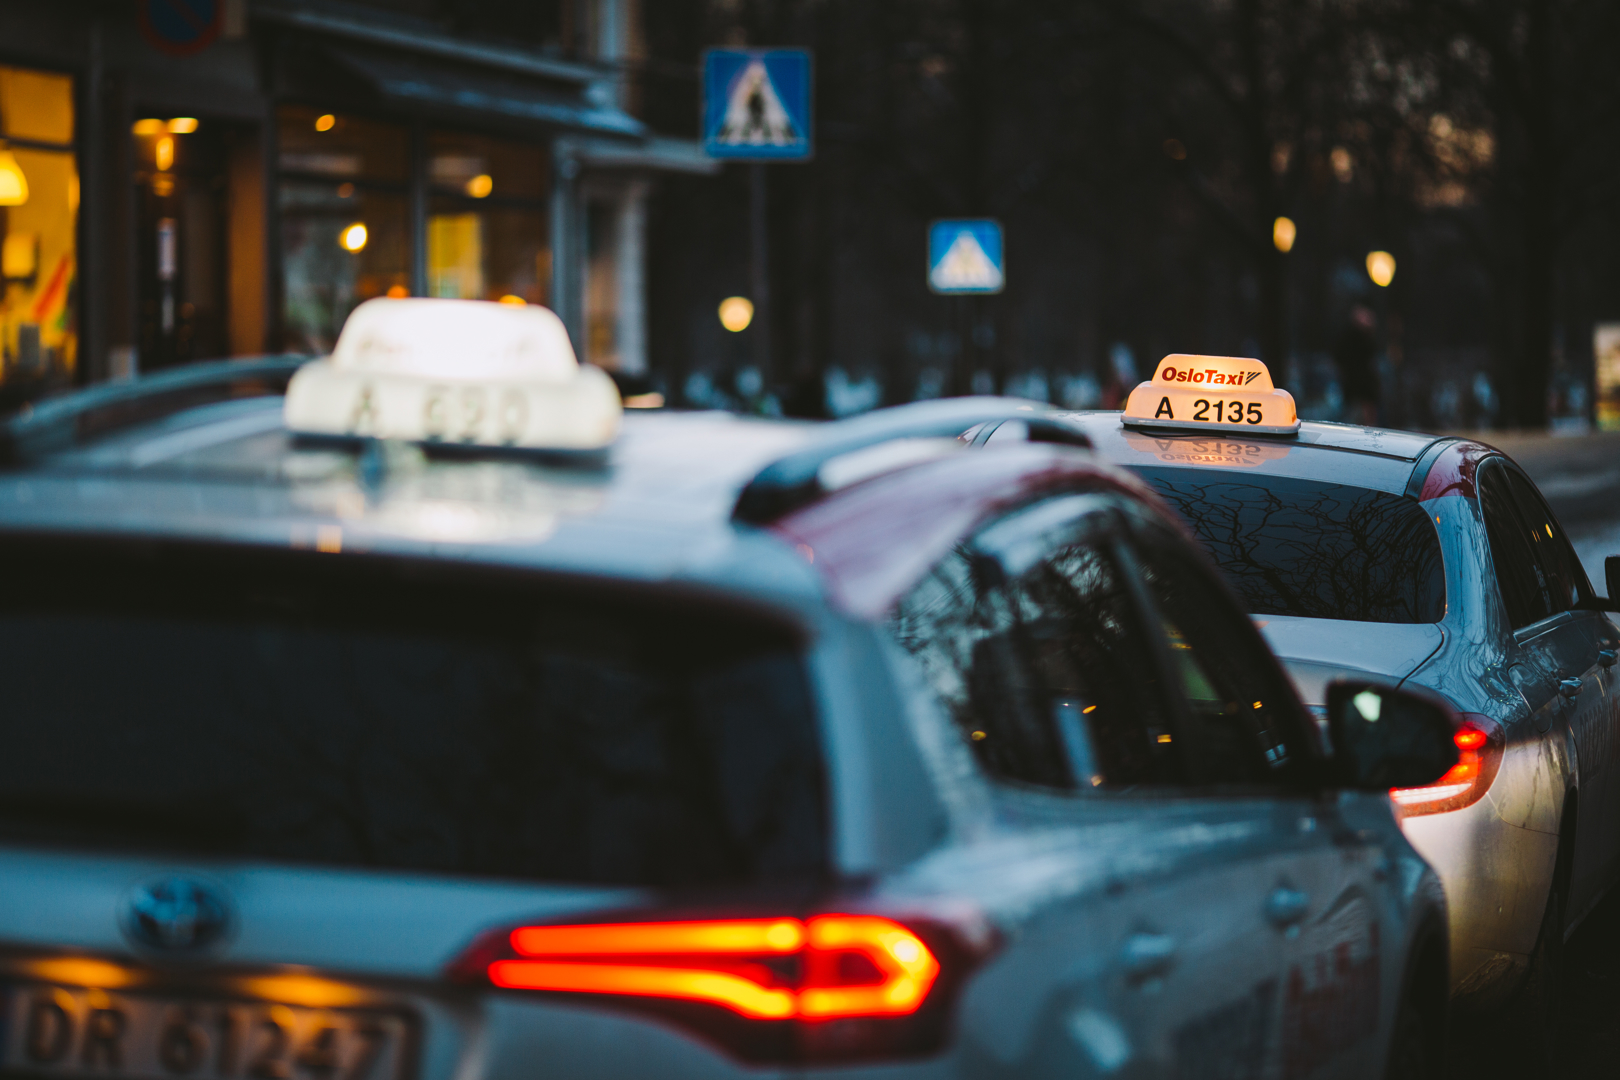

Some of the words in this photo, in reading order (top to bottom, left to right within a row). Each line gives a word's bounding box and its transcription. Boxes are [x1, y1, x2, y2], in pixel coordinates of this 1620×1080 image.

[1161, 366, 1245, 386] OsloTaxi
[346, 382, 380, 436] A
[1154, 396, 1174, 420] A
[1193, 399, 1263, 425] 2135
